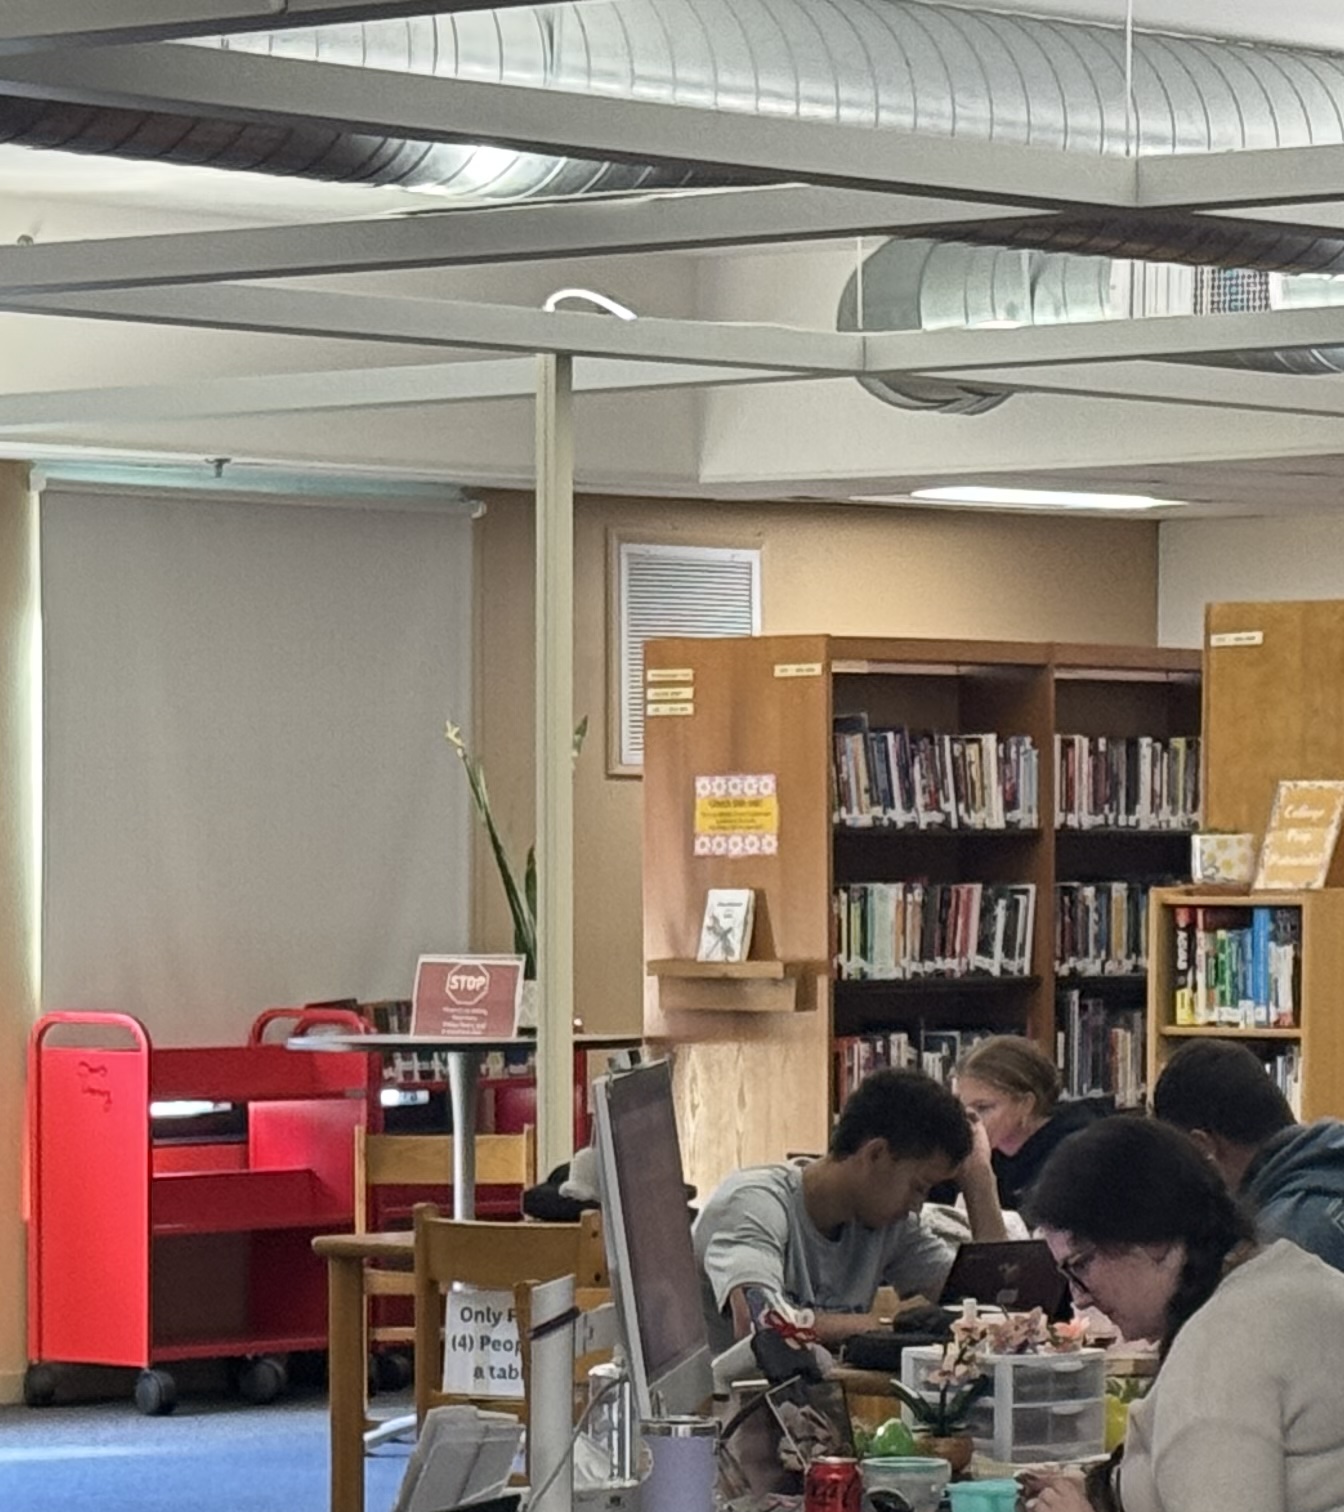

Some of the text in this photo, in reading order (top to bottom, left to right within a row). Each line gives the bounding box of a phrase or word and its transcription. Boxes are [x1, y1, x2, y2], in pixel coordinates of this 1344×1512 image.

[450, 975, 487, 991] STOP
[460, 1307, 503, 1327] Only
[452, 1335, 475, 1352] (4)
[474, 1367, 484, 1381] a
